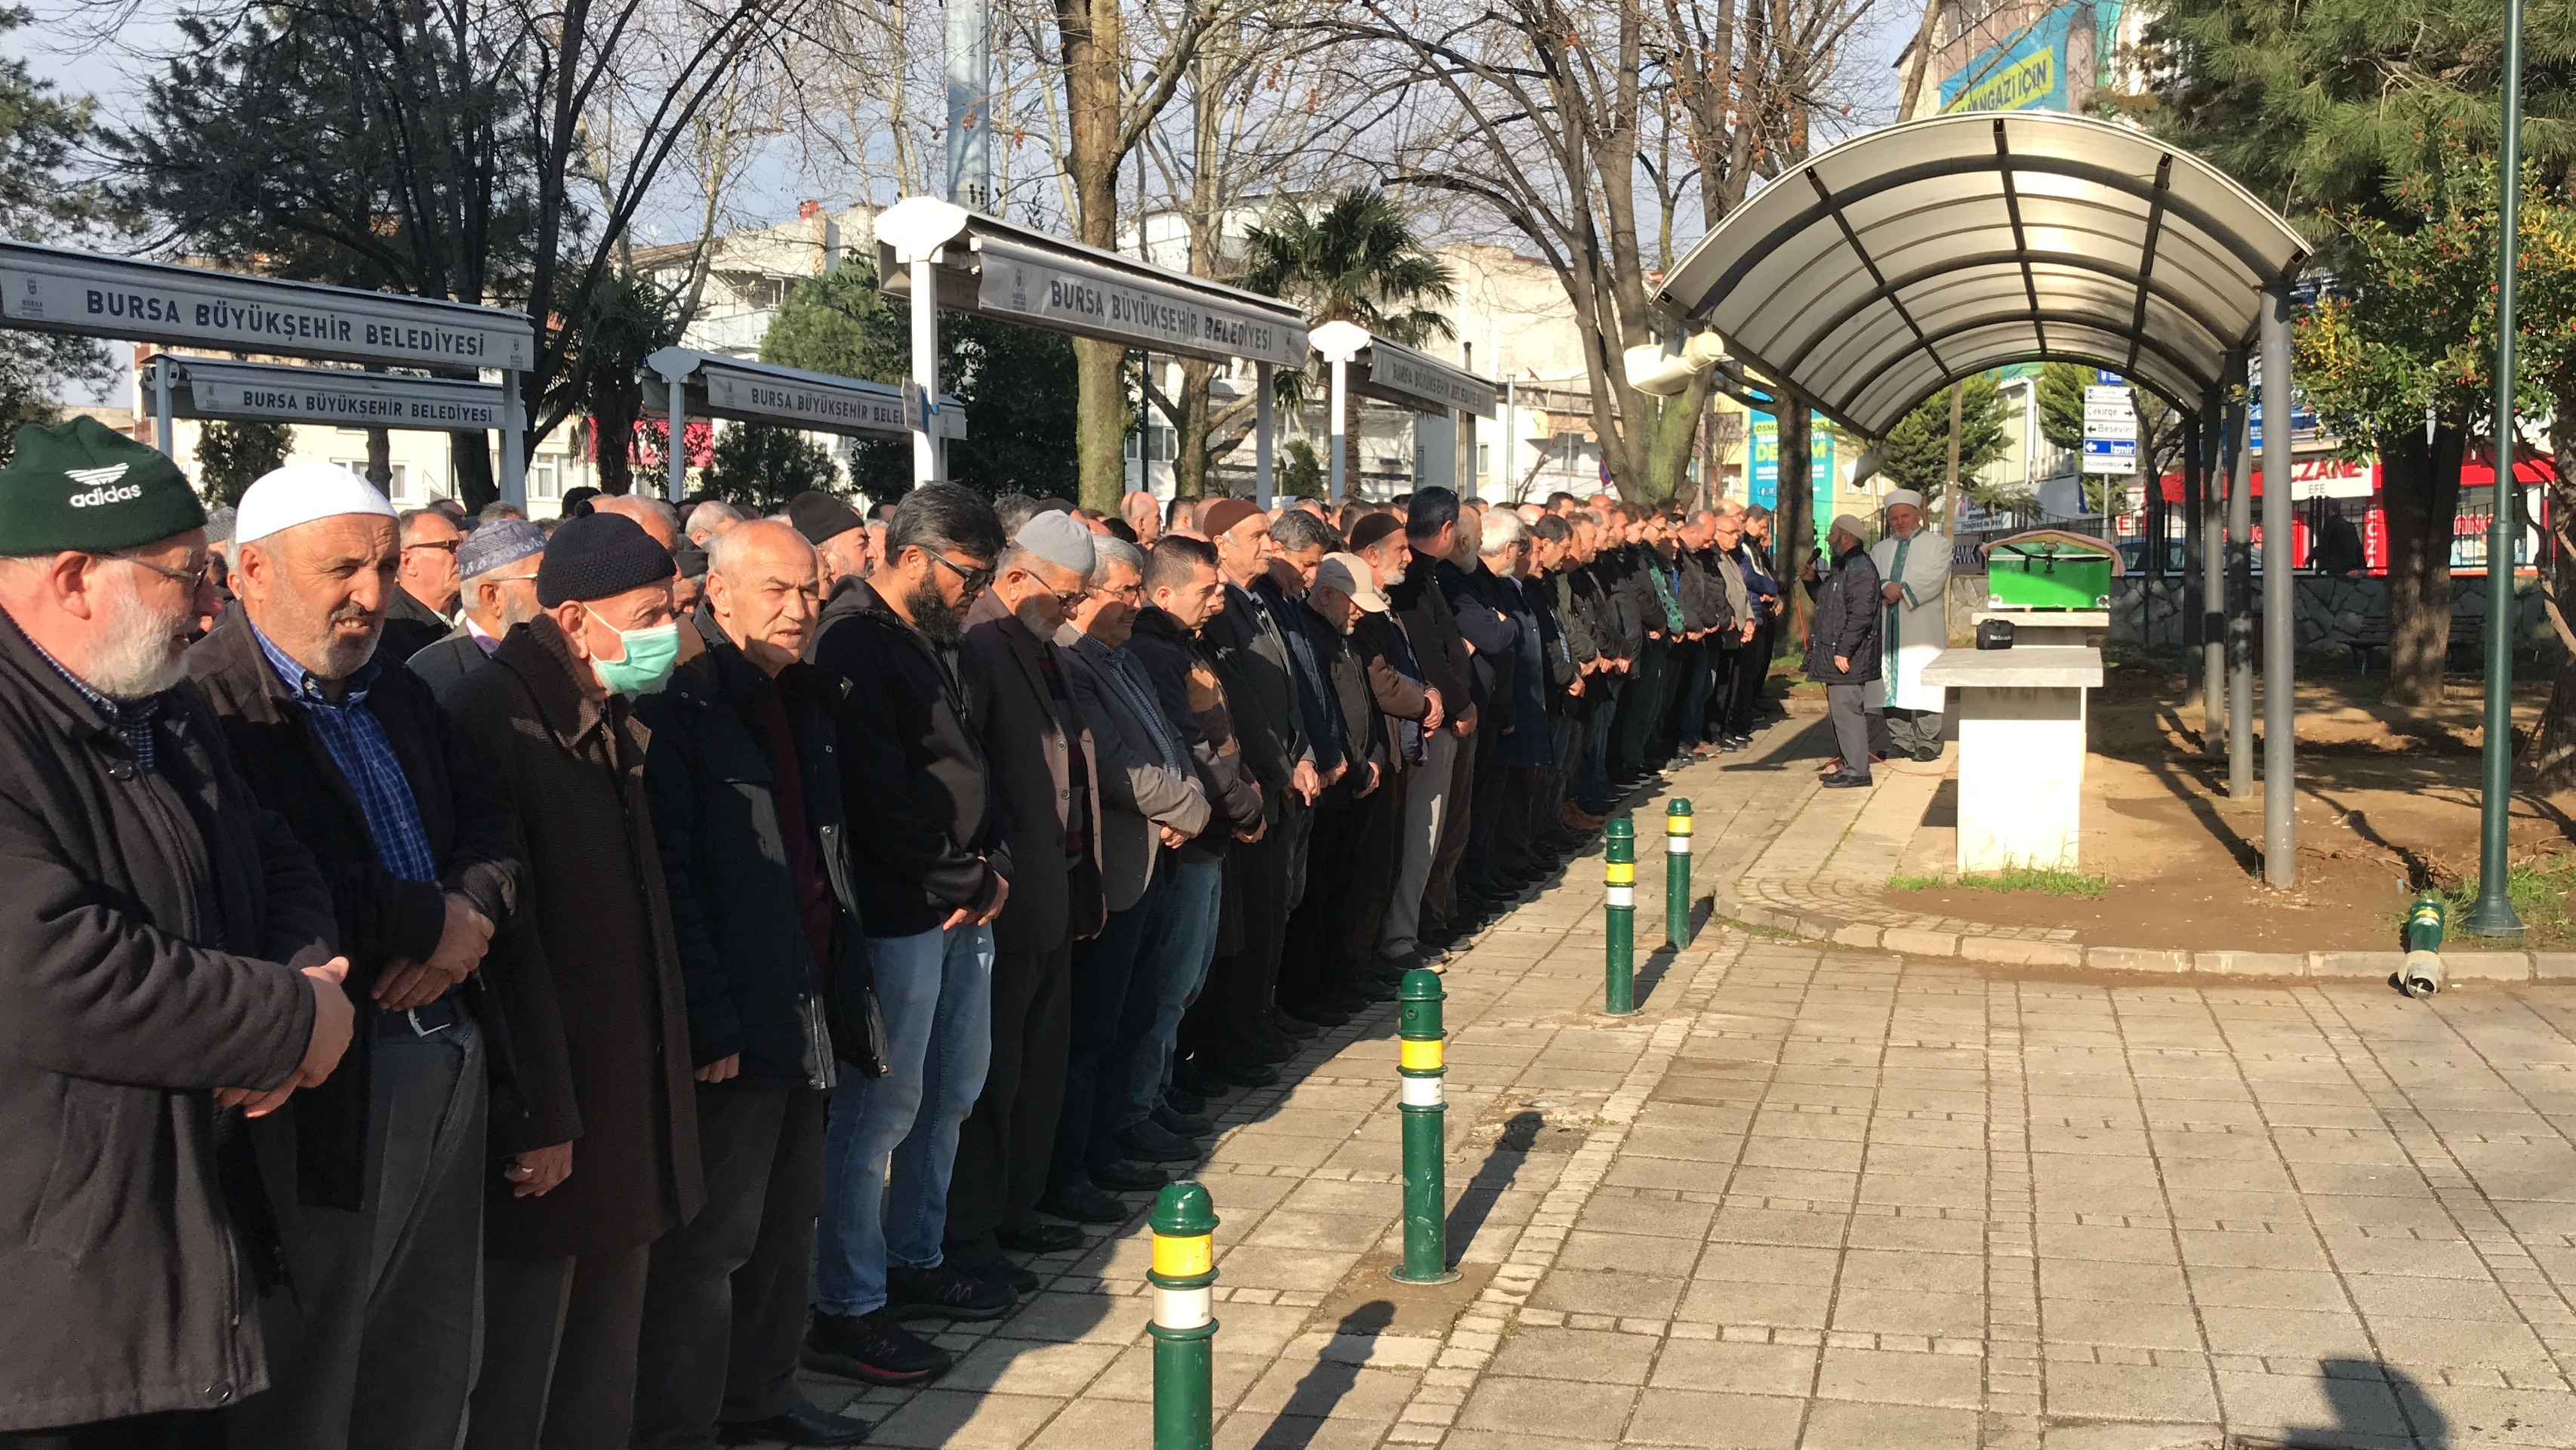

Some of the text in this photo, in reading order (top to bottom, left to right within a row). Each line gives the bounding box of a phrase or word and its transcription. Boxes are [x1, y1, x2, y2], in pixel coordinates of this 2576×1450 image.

[87, 289, 484, 356] BURSA BÜYÜKŞEHİR BELEDİYESİ
[1051, 280, 1104, 317] BURSA
[1112, 290, 1197, 337] BÜYÜKŞEHİR
[1204, 316, 1272, 351] BELEDİYESİ
[243, 390, 492, 422] BURSA BÜYÜKŞEHİR BELEDİYESİ
[752, 388, 792, 409] BURSA
[797, 393, 868, 420] BÜYÜKŞEHİR
[2087, 406, 2118, 418] Çekirge
[2110, 440, 2134, 455] İzmir
[2291, 458, 2363, 483] CZANE
[69, 484, 143, 508] adidas
[2309, 483, 2325, 494] EFE
